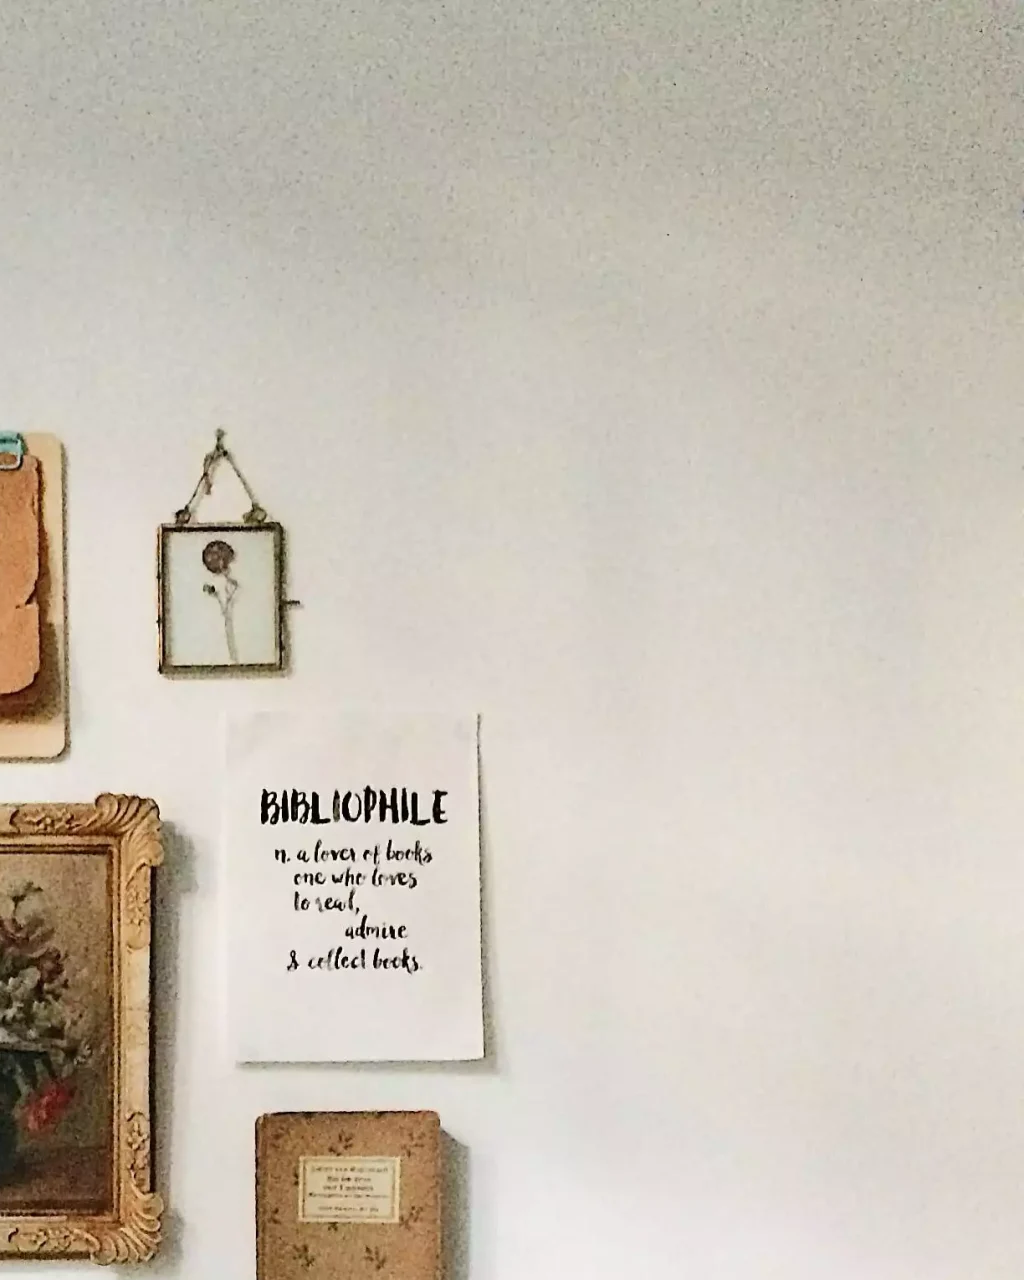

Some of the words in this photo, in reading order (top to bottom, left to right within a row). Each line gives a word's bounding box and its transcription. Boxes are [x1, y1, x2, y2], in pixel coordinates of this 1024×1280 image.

[260, 785, 449, 825] BIBLIOPHILE
[274, 848, 291, 863] n.
[296, 850, 310, 863] a
[314, 839, 356, 863] lover
[362, 845, 381, 866] of
[386, 839, 433, 866] books
[293, 871, 326, 886] one
[331, 867, 366, 887] who
[371, 866, 418, 889] loves
[294, 891, 310, 912] to
[315, 888, 360, 915] read,
[345, 914, 409, 940] admire
[287, 950, 300, 972] &
[308, 946, 366, 971] collect
